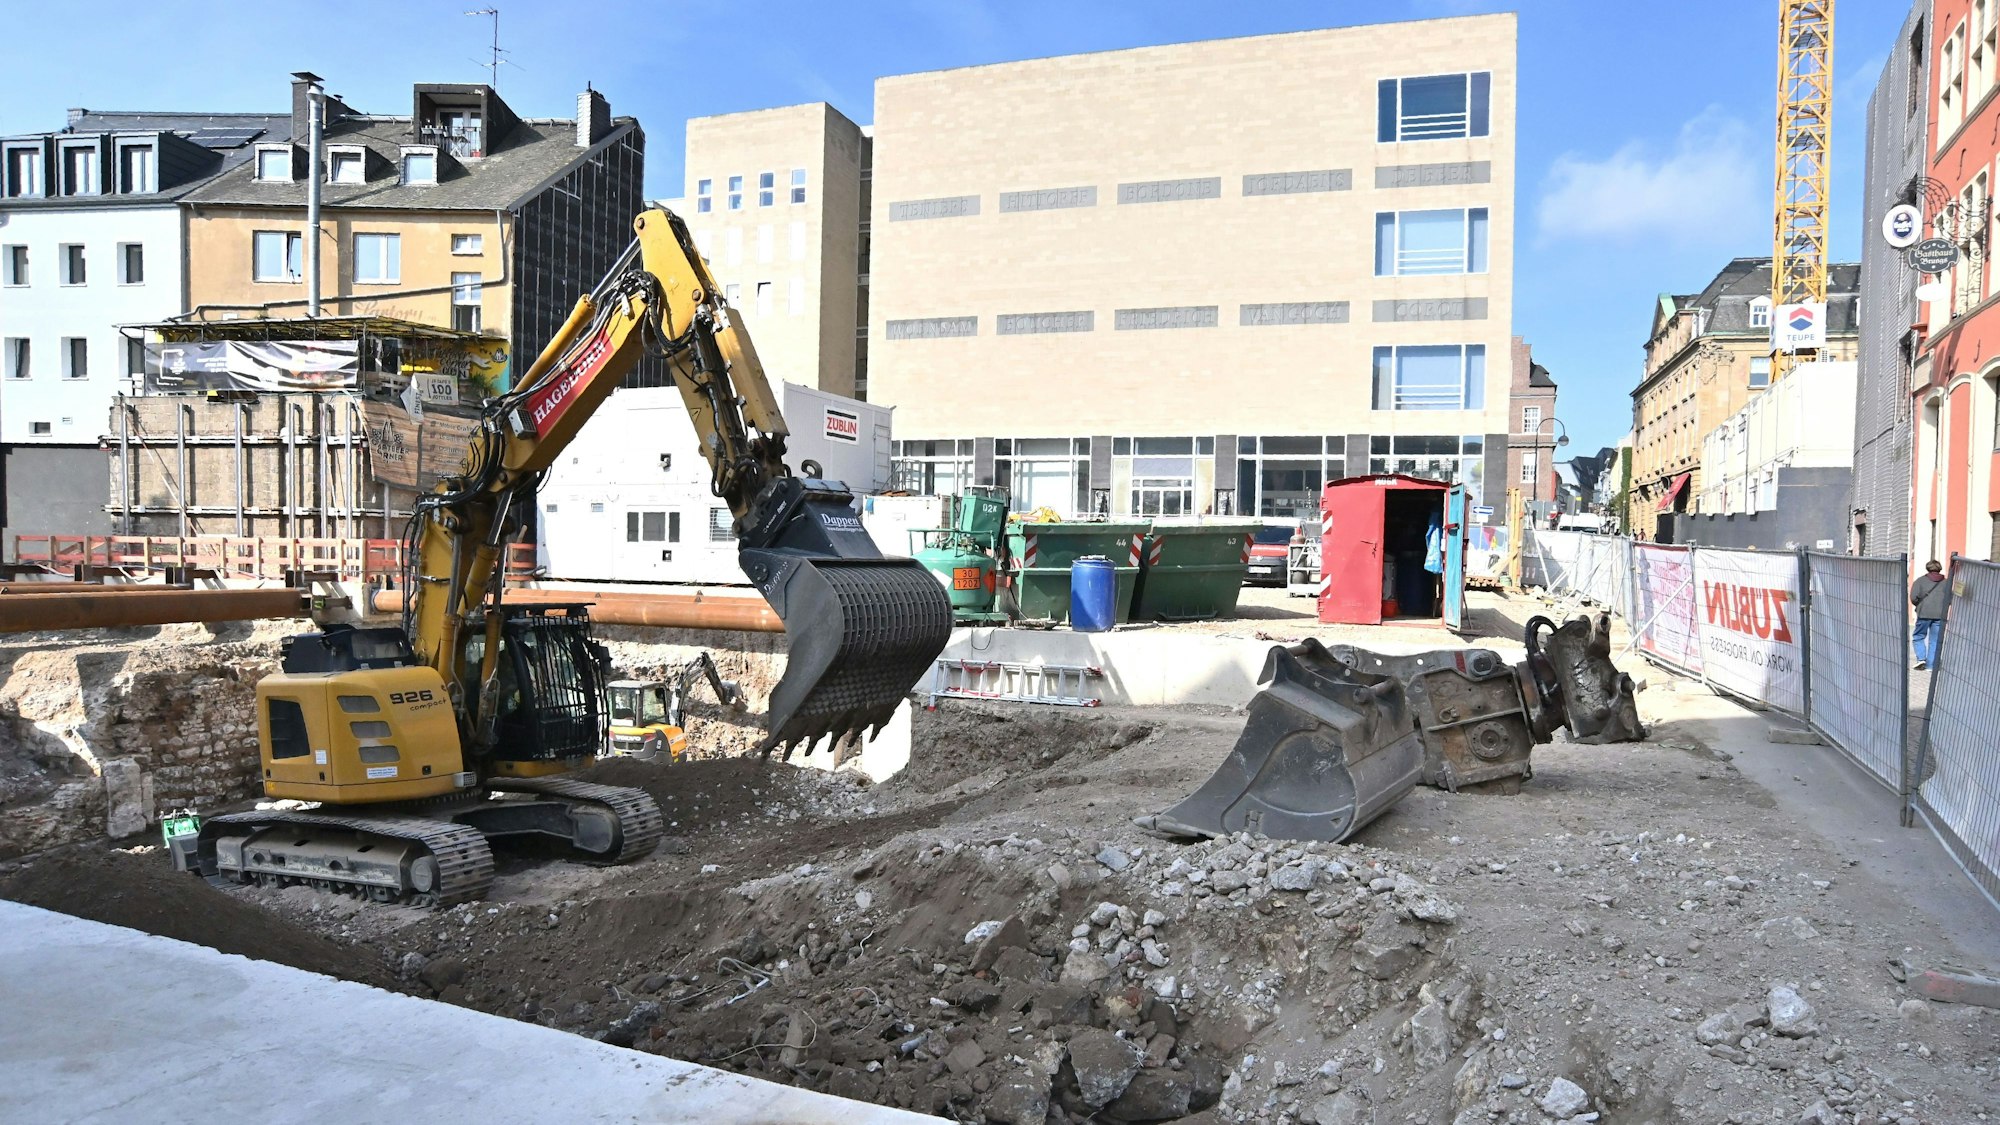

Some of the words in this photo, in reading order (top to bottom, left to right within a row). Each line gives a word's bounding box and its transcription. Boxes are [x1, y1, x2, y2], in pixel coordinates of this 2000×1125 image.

[1914, 248, 1954, 259] Gasthaus
[1919, 257, 1949, 265] Brungs
[1786, 333, 1815, 342] TEUPE
[533, 340, 606, 424] HAGEDORN
[432, 383, 452, 395] 100
[826, 416, 857, 434] ZÜBLIN
[820, 513, 860, 529] Dappen
[1116, 538, 1127, 547] 44
[1227, 537, 1237, 546] 43
[962, 569, 973, 578] 30
[957, 579, 979, 588] 1202
[389, 689, 433, 705] 926
[409, 697, 447, 712] compact
